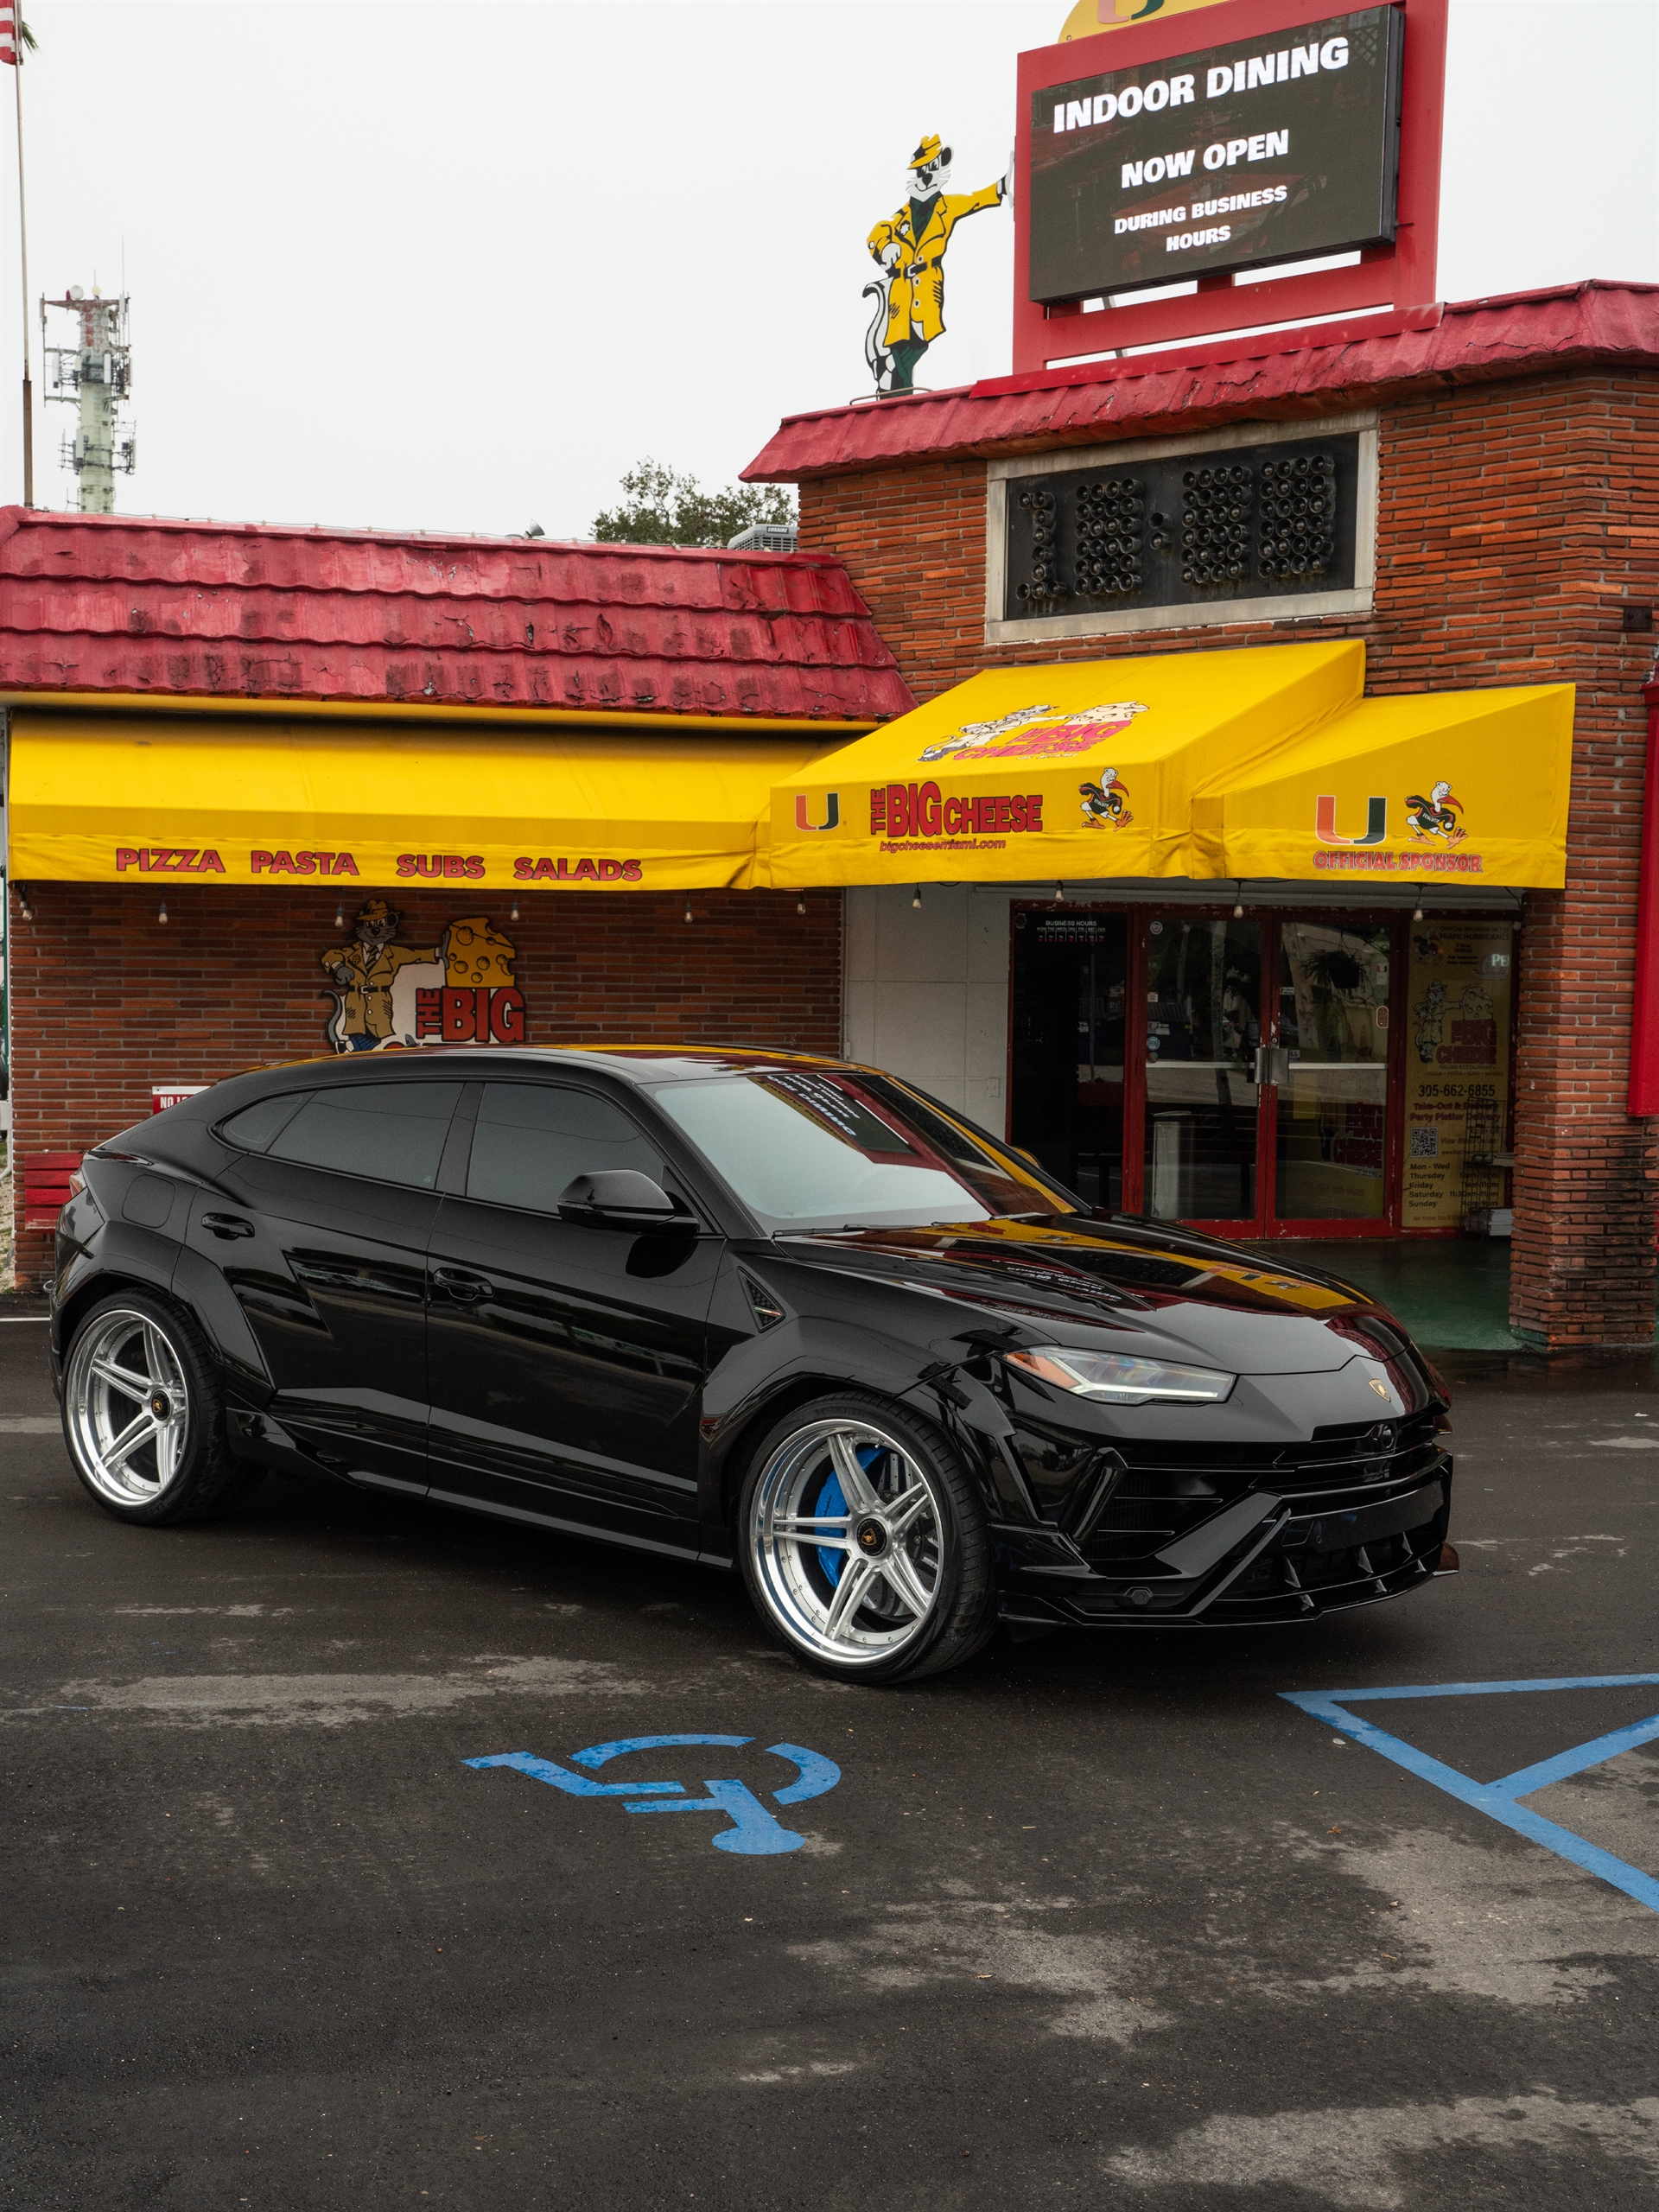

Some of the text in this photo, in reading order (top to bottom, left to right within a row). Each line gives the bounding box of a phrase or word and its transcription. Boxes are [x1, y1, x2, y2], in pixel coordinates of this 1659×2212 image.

[1053, 36, 1349, 134] INDOOR DINING
[1121, 129, 1289, 188] NOW OPEN
[1114, 185, 1287, 234] DURING BUSINESS
[1166, 225, 1231, 252] HOURS
[1030, 721, 1132, 743] BIG
[952, 738, 1105, 760] CHEESE
[794, 781, 1043, 837] U THE BIG CHEESE
[1315, 795, 1387, 845] U
[880, 837, 1007, 853] bigcheesemiami.com
[116, 848, 643, 882] PIZZA PASTA SUBS SALADS
[1313, 851, 1484, 873] OFFICIAL SPONSOR
[416, 987, 526, 1043] THE BIG
[1461, 1020, 1497, 1046] BIG
[1436, 1046, 1497, 1065] CHEESE
[160, 1096, 174, 1109] NO
[1419, 1084, 1495, 1096] 305-662-6855
[1410, 1113, 1433, 1122] Party
[1435, 1112, 1464, 1121] Platter
[1413, 1102, 1452, 1110] Take-Out
[1333, 1135, 1382, 1169] CHEESE
